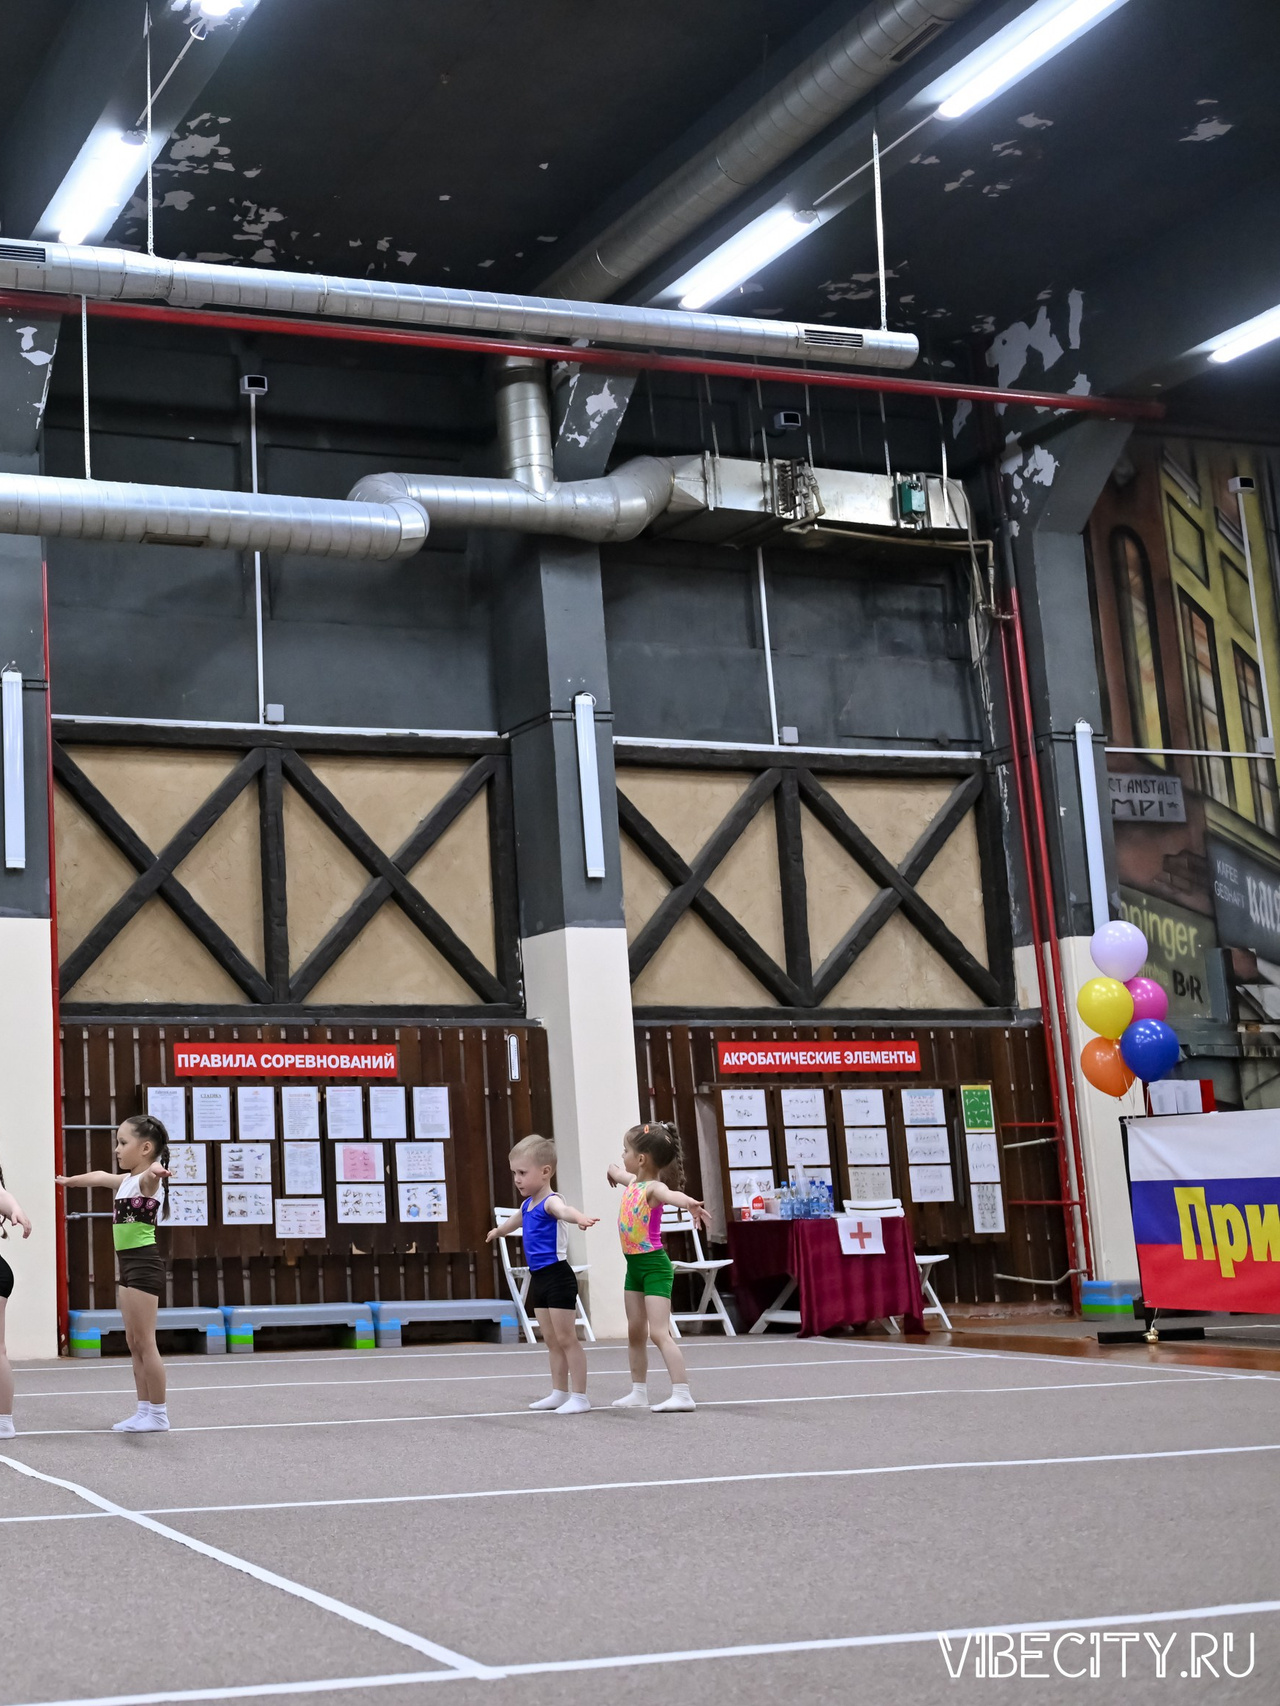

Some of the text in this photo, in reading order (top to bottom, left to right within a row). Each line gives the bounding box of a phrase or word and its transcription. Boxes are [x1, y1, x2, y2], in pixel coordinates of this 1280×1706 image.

[1127, 779, 1178, 795] ANSTALT
[177, 1053, 395, 1069] ПРАВИЛА СОРЕВНОВАНИЙ
[723, 1051, 917, 1066] АКРОБАТИЧЕСКИЕ ЭЛЕМЕНТЫ
[1173, 1187, 1280, 1278] При
